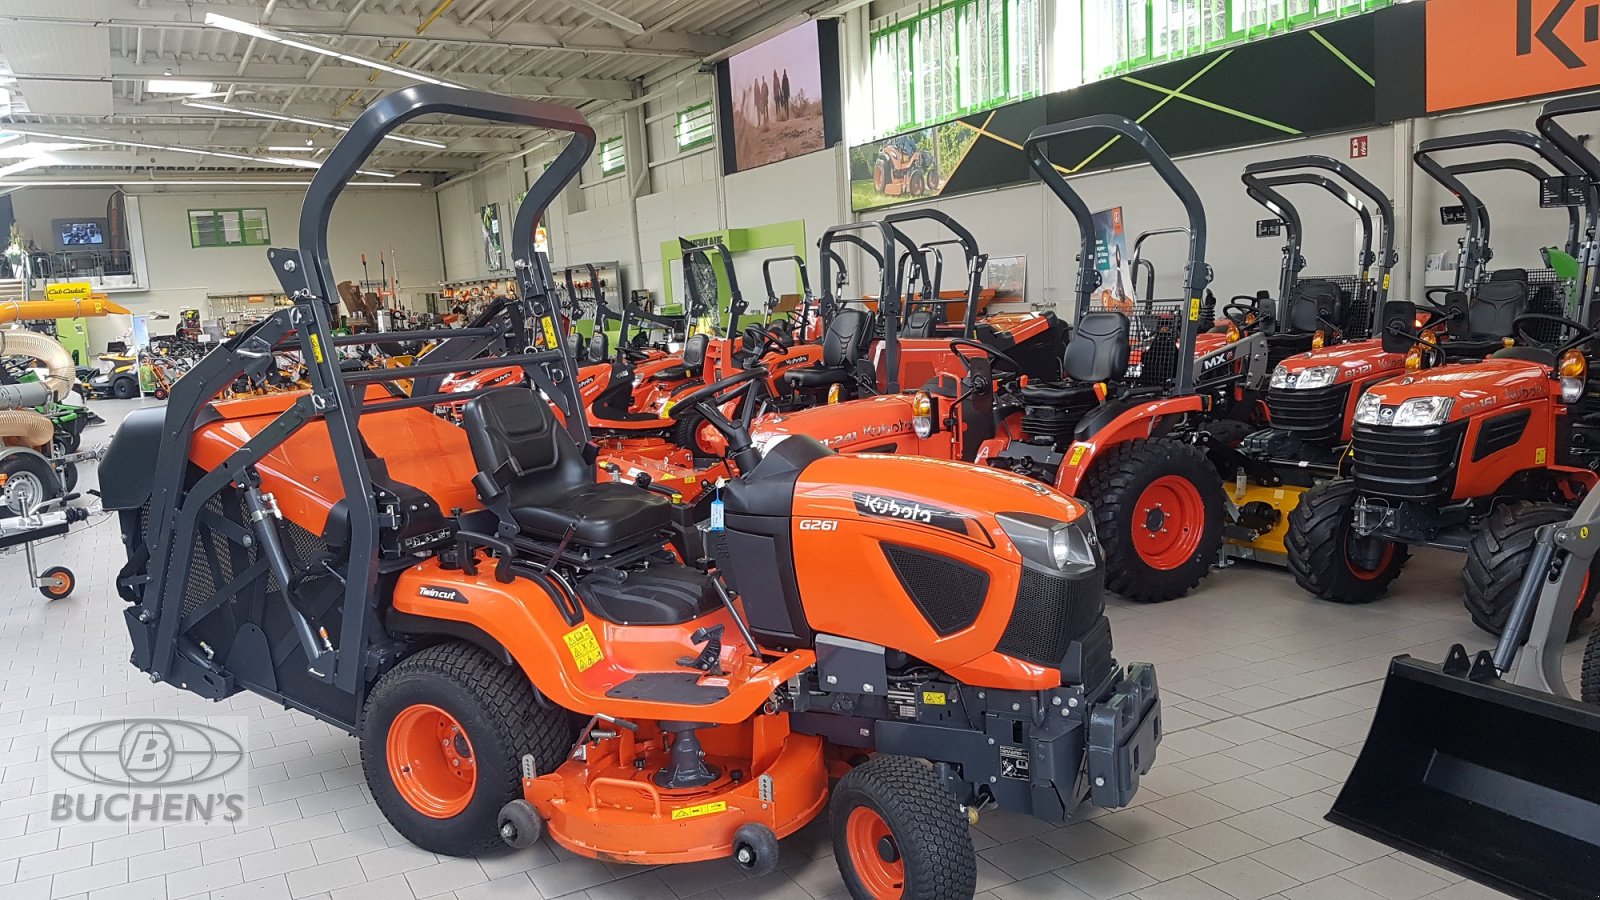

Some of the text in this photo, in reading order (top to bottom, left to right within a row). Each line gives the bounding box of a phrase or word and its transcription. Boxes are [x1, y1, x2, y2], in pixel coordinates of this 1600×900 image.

[1204, 353, 1226, 370] MX
[864, 494, 931, 523] Kubota
[799, 519, 838, 531] G261
